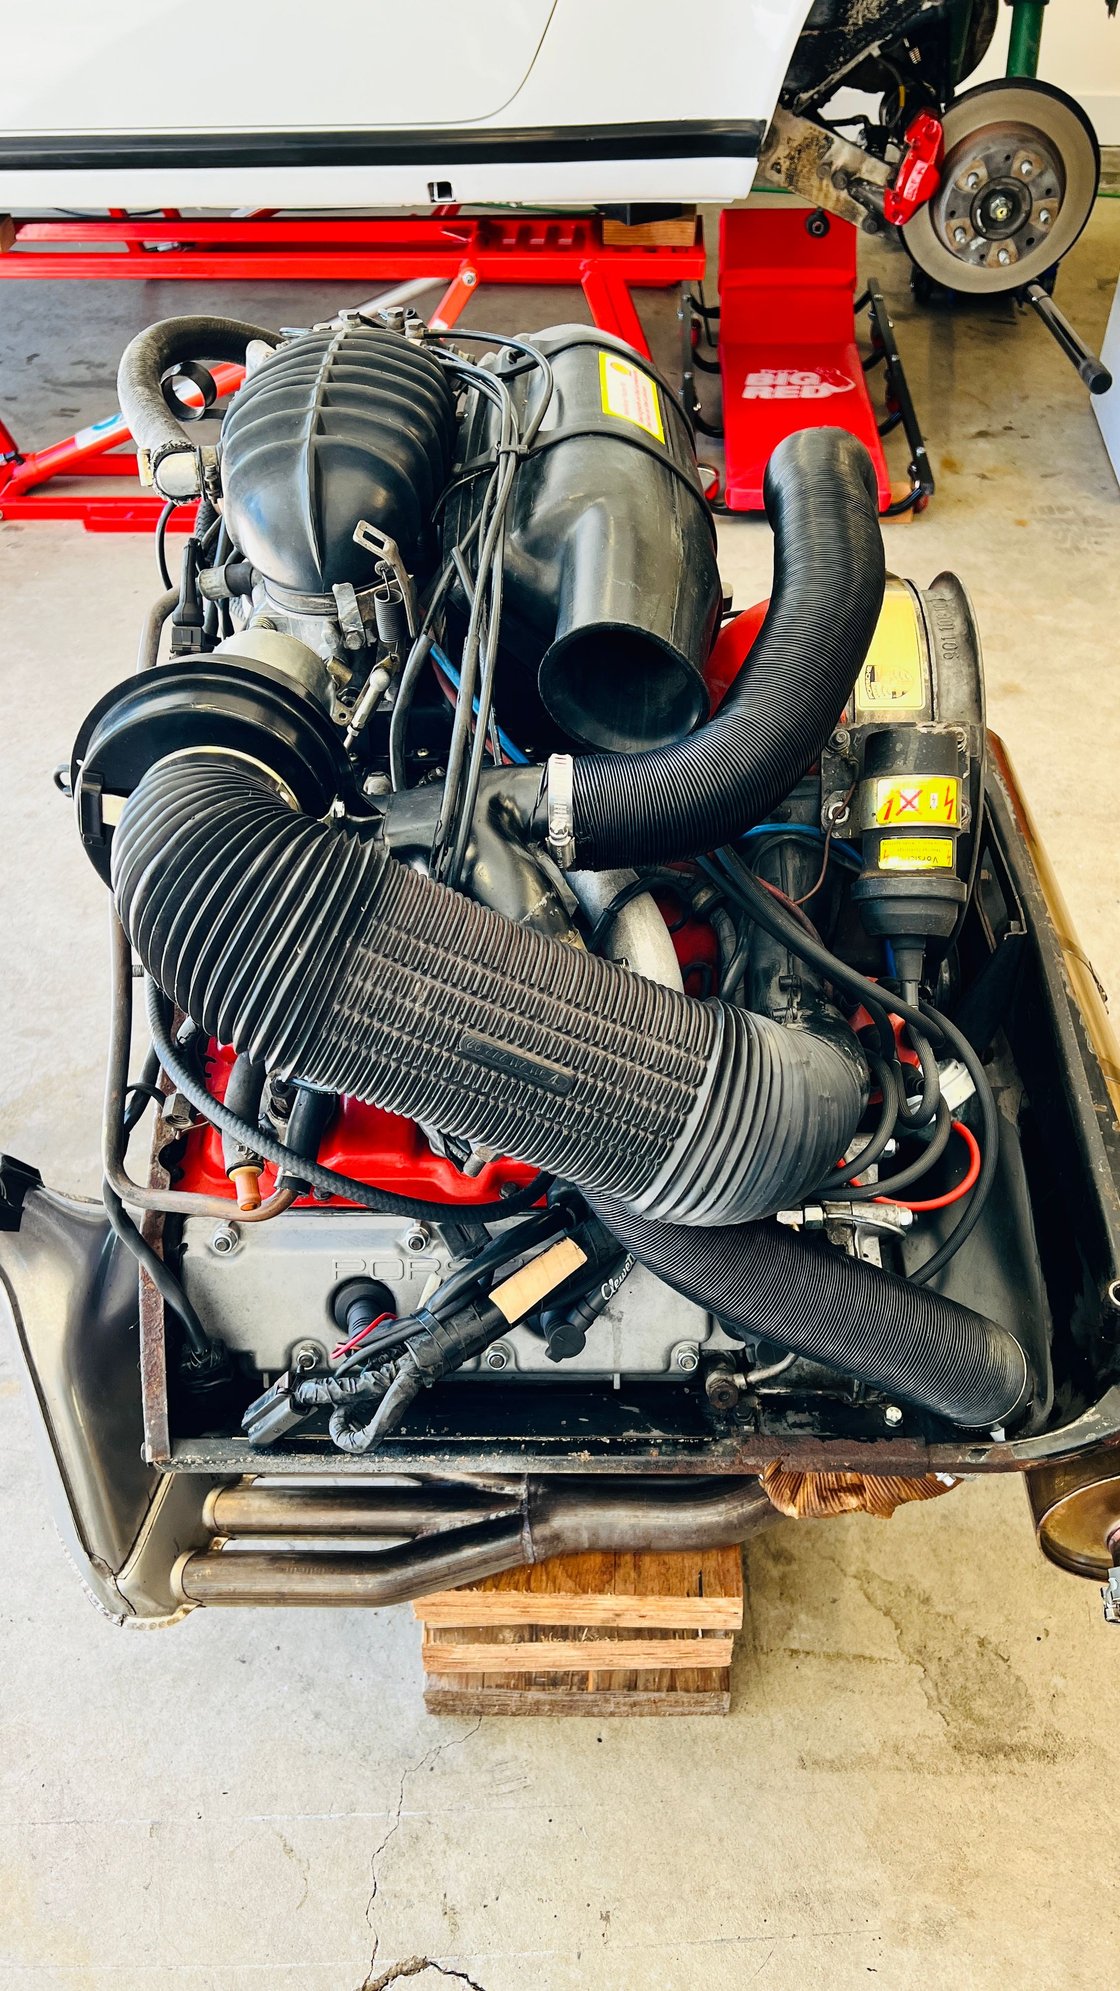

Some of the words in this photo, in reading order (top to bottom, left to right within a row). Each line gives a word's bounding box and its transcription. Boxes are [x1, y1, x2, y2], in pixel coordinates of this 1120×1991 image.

[745, 371, 821, 385] BIG
[742, 384, 833, 400] RED
[333, 1258, 473, 1281] PORS
